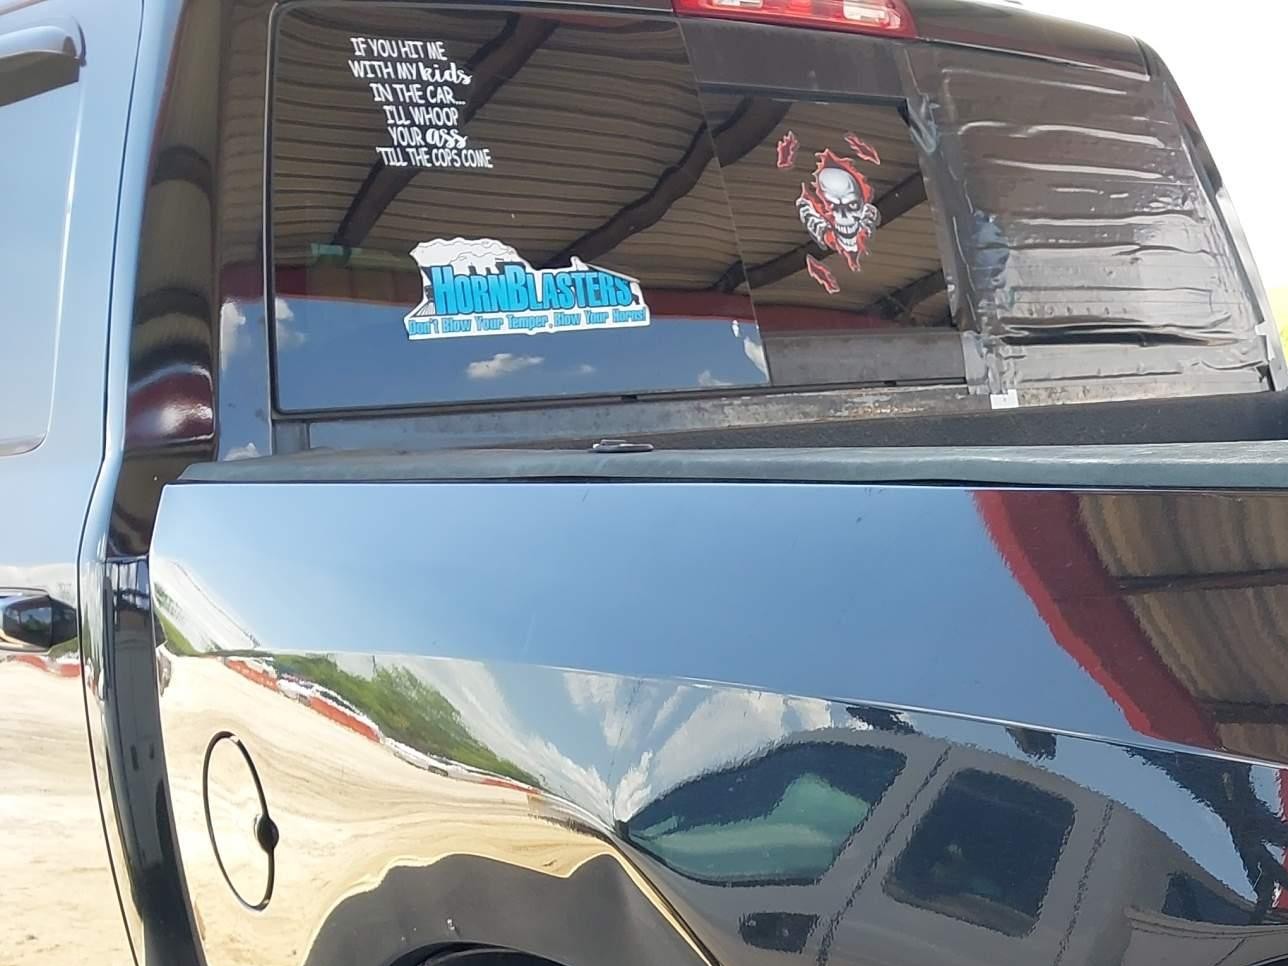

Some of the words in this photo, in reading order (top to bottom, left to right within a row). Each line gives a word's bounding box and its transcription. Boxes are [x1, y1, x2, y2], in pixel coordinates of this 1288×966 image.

[350, 37, 367, 56] IF
[367, 39, 398, 57] YOU
[398, 40, 424, 58] HIT
[426, 41, 448, 60] ME
[348, 60, 395, 79] WITH
[396, 61, 416, 80] MY
[418, 62, 472, 85] kids
[369, 83, 393, 102] IN
[392, 84, 425, 103] THE
[426, 85, 466, 105] CAR...
[409, 106, 459, 126] WHOOP
[387, 126, 425, 146] YOUR
[425, 128, 468, 149] ass
[405, 147, 432, 167] THE
[431, 148, 461, 168] COPS
[461, 148, 494, 168] COME
[408, 318, 440, 335] Don't
[441, 317, 472, 333] Blow
[473, 315, 504, 331] Your
[553, 311, 581, 327] Blow
[583, 309, 609, 325] Your
